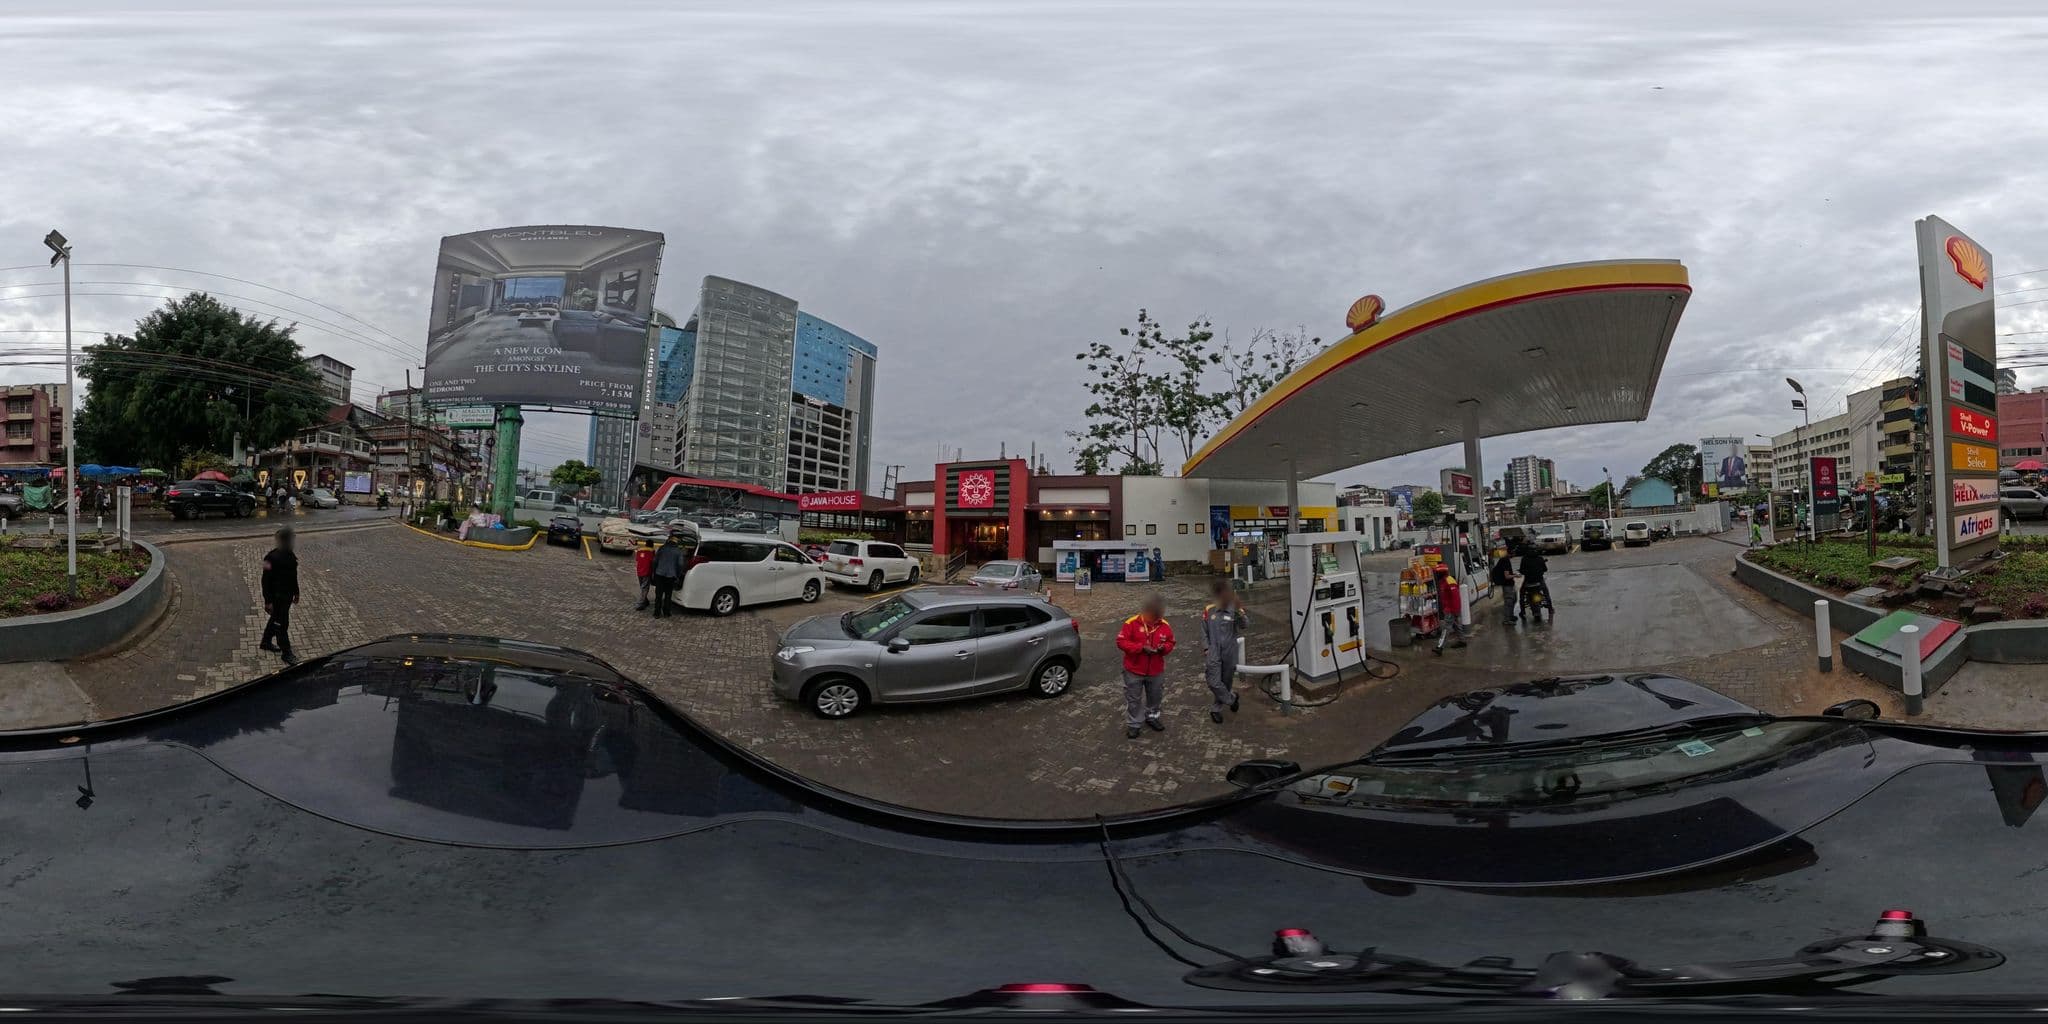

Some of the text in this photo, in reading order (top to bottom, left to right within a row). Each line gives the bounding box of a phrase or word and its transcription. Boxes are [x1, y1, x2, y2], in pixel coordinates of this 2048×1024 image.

[504, 346, 529, 355] NEW
[533, 346, 562, 355] ICON
[474, 364, 581, 374] THE CITY'S SKYLINE
[429, 385, 465, 393] BEDROOMS
[580, 379, 634, 391] PRICE FROM
[600, 388, 633, 399] 7.15M
[1960, 412, 1972, 421] Shell
[1960, 420, 1989, 437] V-Power
[1967, 447, 1979, 455] Shell
[1967, 456, 1986, 468] Select
[1953, 482, 1965, 491] Shell
[810, 495, 857, 506] JAVA HOUSE
[1954, 489, 1978, 503] HELIX
[1960, 516, 1993, 535] Afrigas
